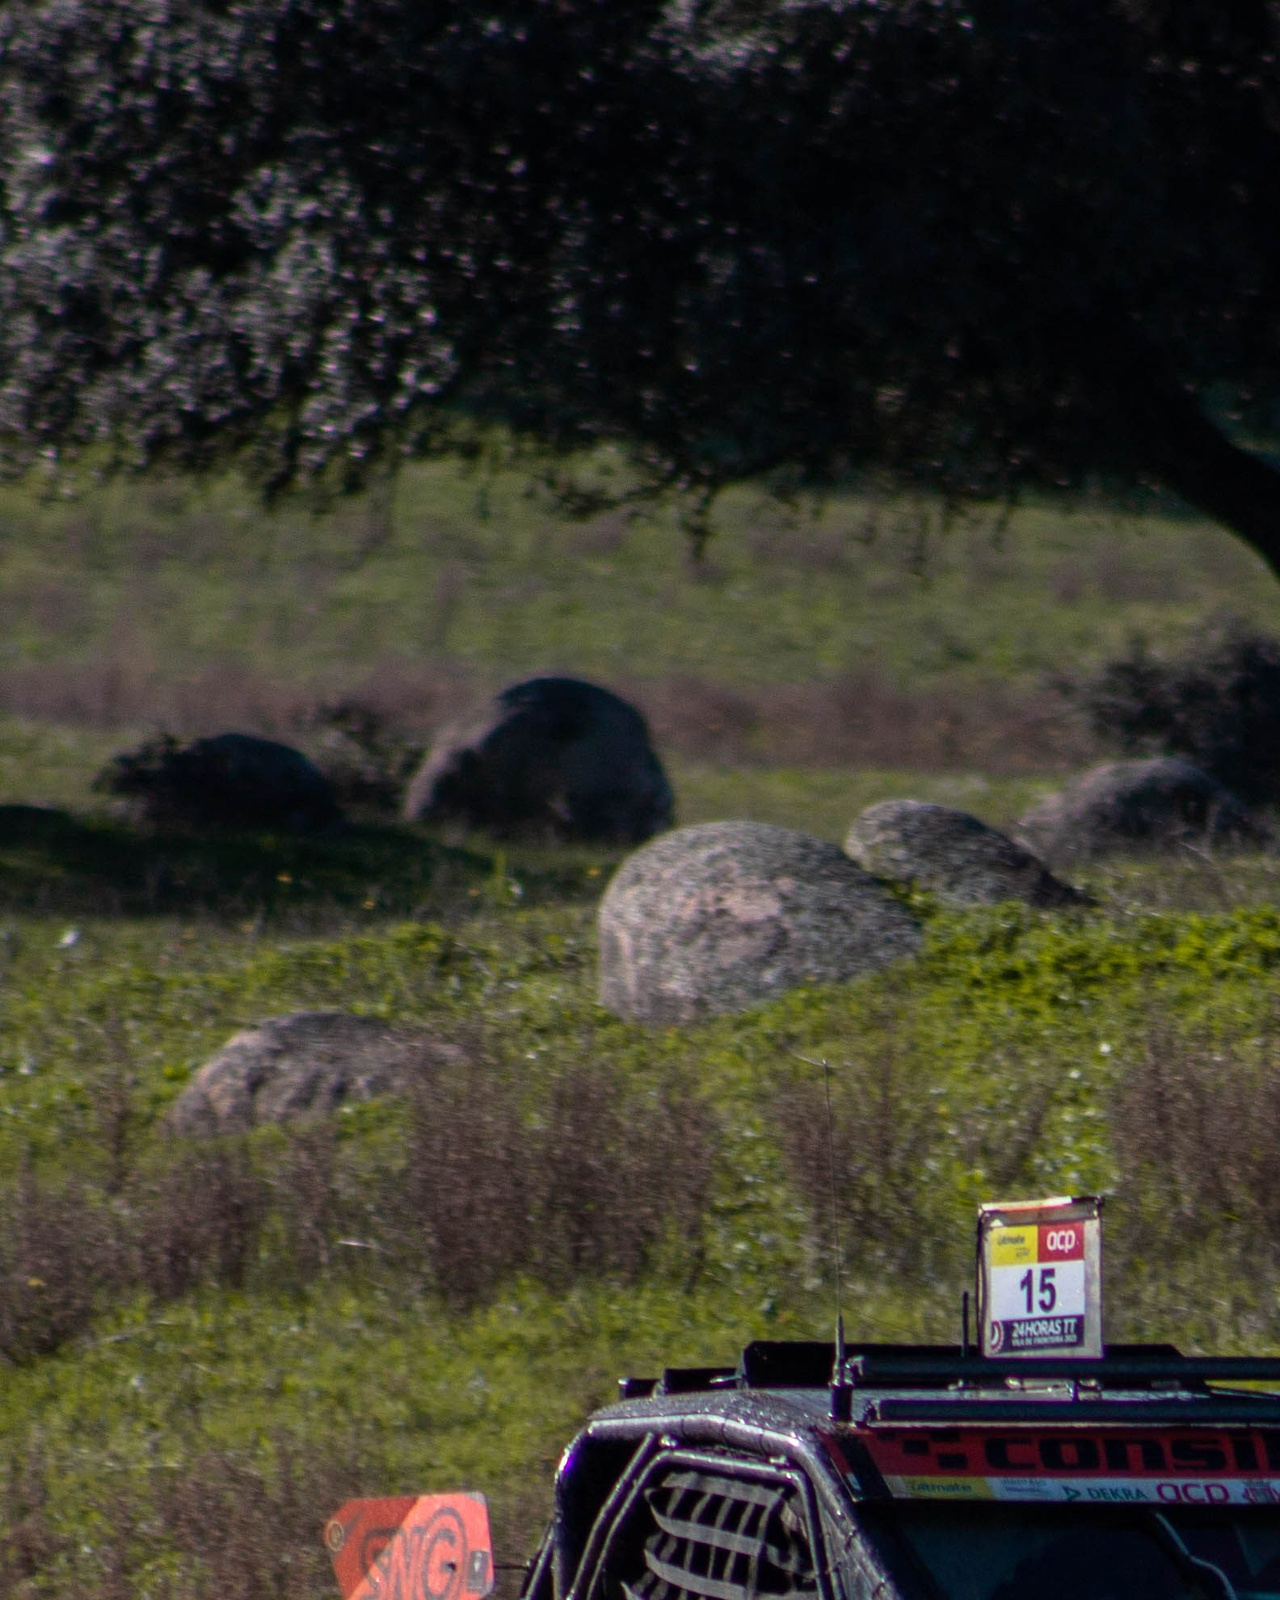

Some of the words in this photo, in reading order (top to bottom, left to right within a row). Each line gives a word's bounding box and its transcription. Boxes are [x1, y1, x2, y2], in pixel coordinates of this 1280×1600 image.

[1020, 1268, 1057, 1314] 15
[1063, 1317, 1077, 1334] TT
[1086, 1487, 1149, 1501] DEKRA
